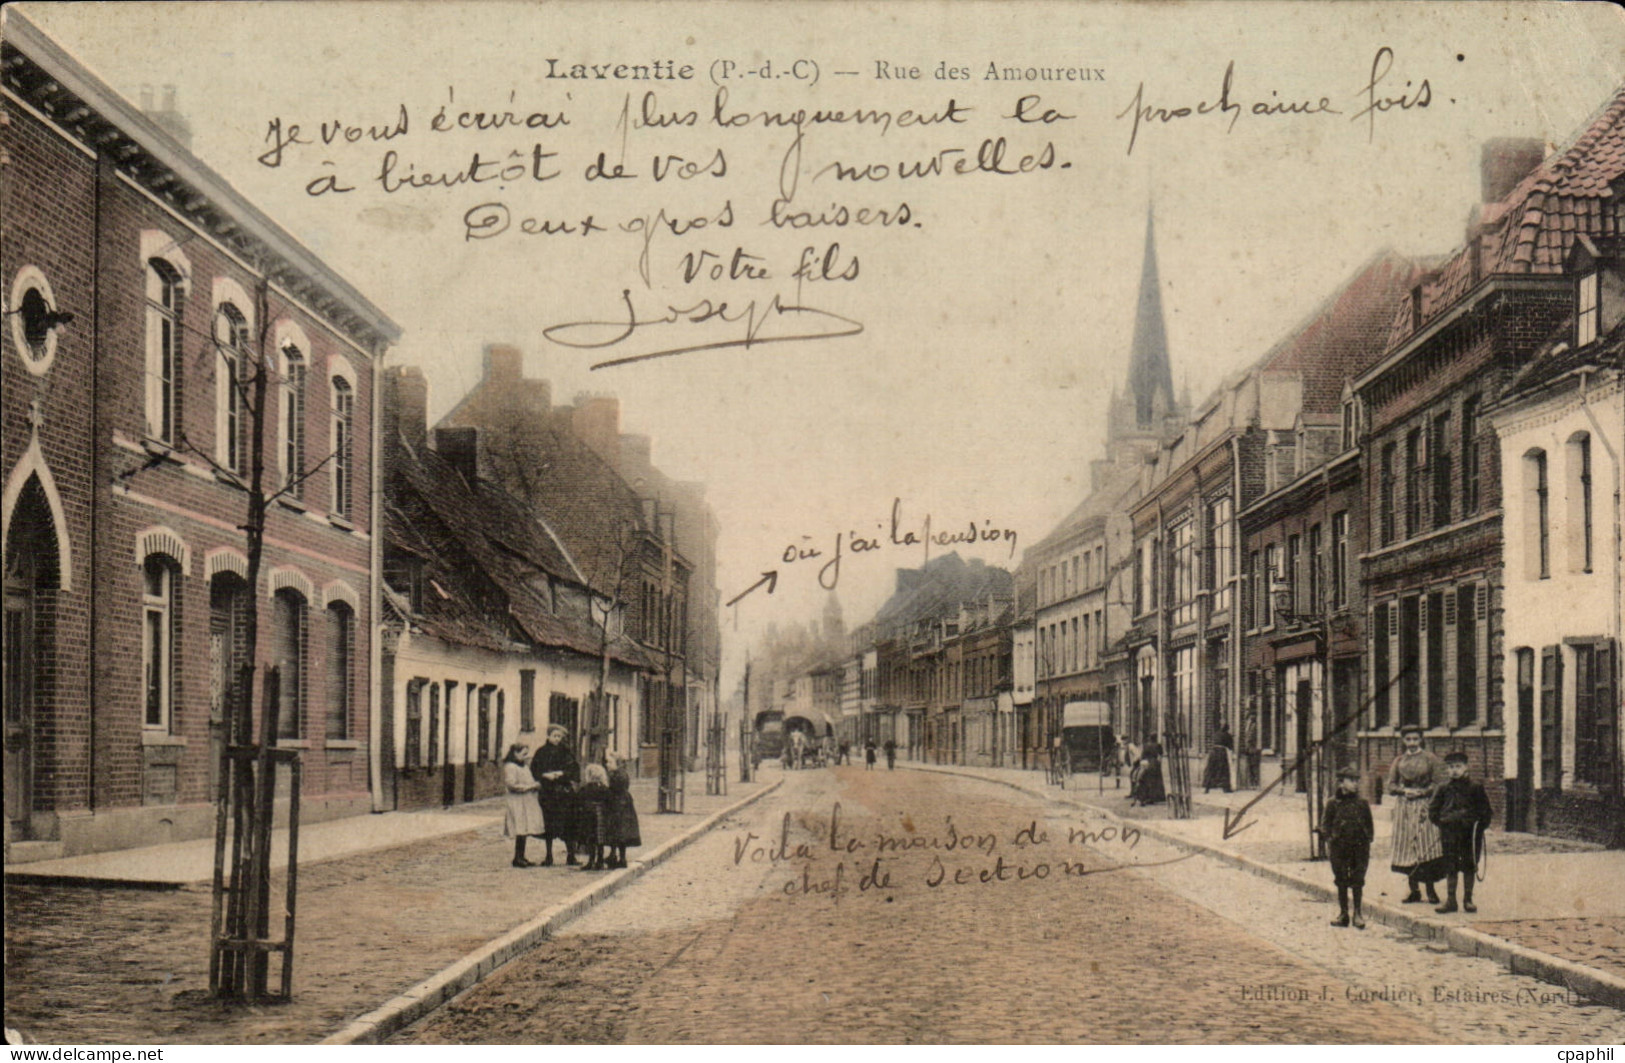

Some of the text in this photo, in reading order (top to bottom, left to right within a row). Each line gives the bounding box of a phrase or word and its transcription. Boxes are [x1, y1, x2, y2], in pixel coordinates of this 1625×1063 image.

[321, 104, 409, 144] vous
[616, 91, 698, 166] plus
[713, 86, 973, 201] longuement
[1003, 94, 1076, 124] la
[1117, 60, 1343, 156] prochaine
[585, 153, 637, 182] de
[653, 148, 727, 182] vos
[464, 200, 922, 290] Deux gros baisers.
[680, 242, 861, 309] Votre fils
[543, 289, 864, 349] Joseph
[891, 497, 920, 545] la
[924, 513, 1018, 574] pension
[877, 815, 997, 856] maison
[1015, 820, 1049, 846] de
[1069, 826, 1142, 850] mon
